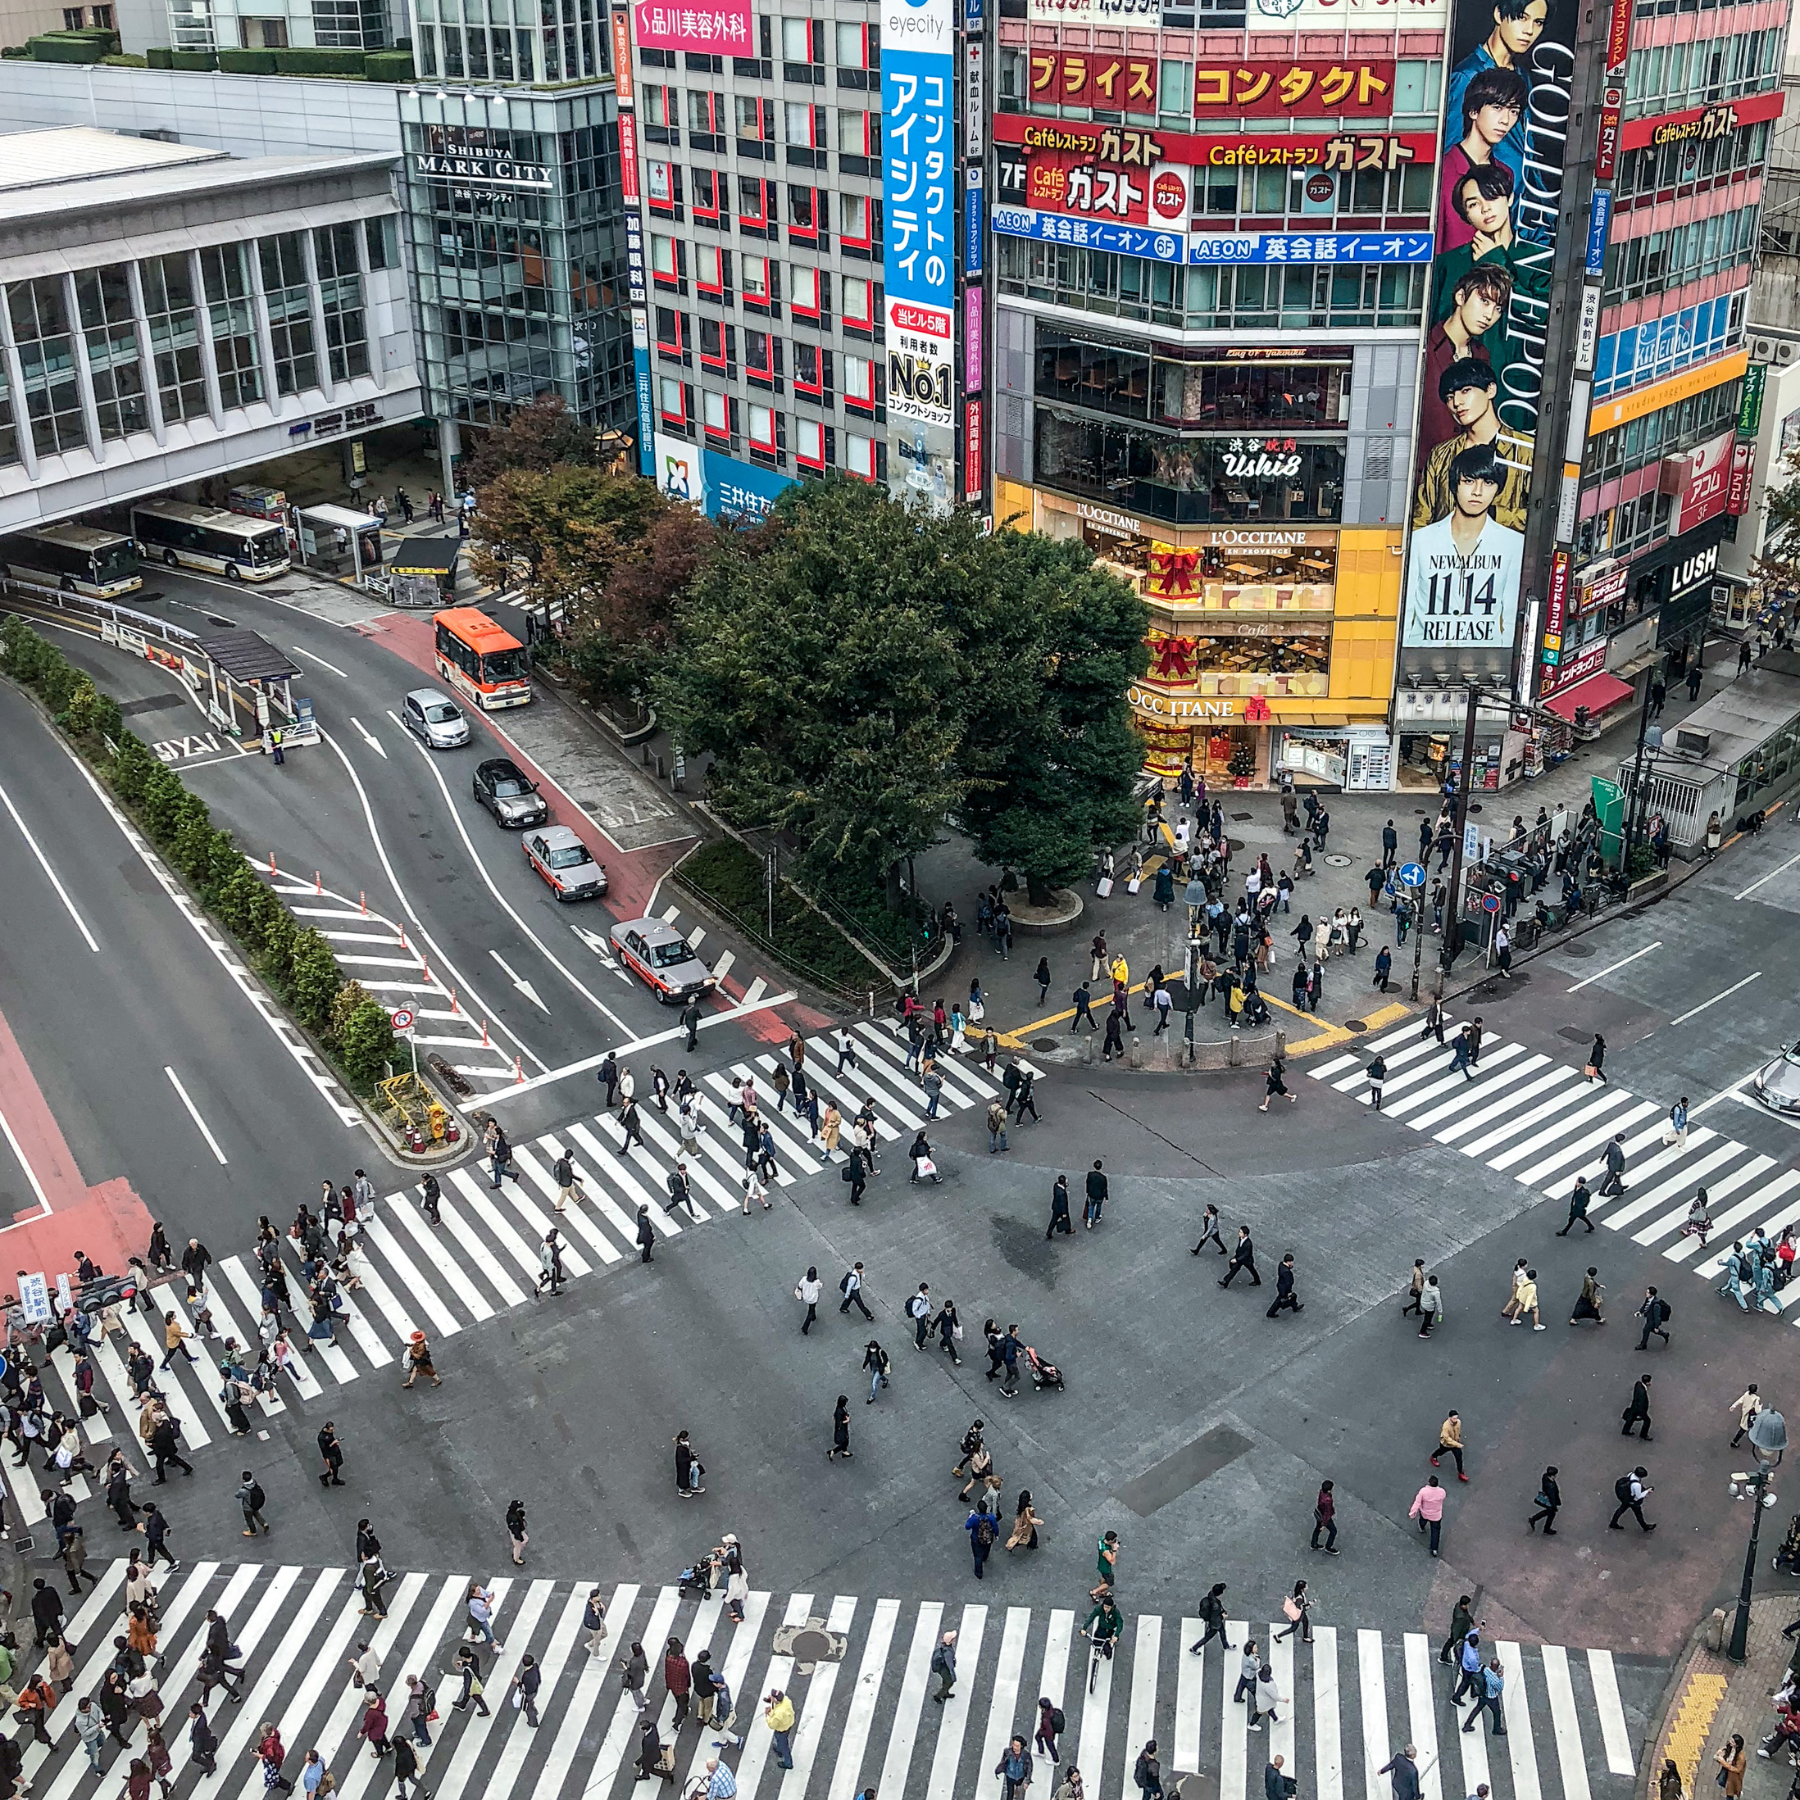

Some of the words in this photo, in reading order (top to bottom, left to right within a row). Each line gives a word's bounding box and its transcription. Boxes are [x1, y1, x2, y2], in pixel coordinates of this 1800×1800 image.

[1616, 0, 1628, 18] イス
[651, 7, 746, 43] 品川美容外科
[889, 15, 944, 41] eyecity
[617, 26, 629, 95] 東京スター銀行
[1614, 66, 1624, 76] 8F
[1032, 55, 1154, 99] プライス
[1197, 66, 1388, 105] コンタクト
[968, 70, 980, 143] 献血ルーム
[1701, 106, 1739, 141] ガスト
[448, 144, 512, 159] SHIBUYA
[970, 146, 979, 155] 6F
[1100, 128, 1161, 166] ガスト
[1209, 144, 1319, 165] Caféレストラン
[1324, 136, 1414, 171] ガスト
[1513, 41, 1576, 276] GOLDEN
[1600, 126, 1617, 169] ガスト
[416, 155, 485, 176] MARK
[495, 162, 552, 181] CITY
[889, 72, 917, 282] アイシティ
[924, 76, 946, 287] コンタクトの
[1001, 163, 1027, 188] 7F
[1033, 166, 1065, 188] Café
[1033, 187, 1064, 202] レストラン
[1066, 166, 1142, 216] ガスト
[1156, 190, 1183, 207] ガスト
[1309, 186, 1332, 195] ガスト
[997, 210, 1031, 232] AEON
[1041, 216, 1149, 252] 英会話イーオン
[1590, 197, 1607, 267] 英会話イーオン
[626, 215, 644, 286] 加藤眼科
[1157, 239, 1173, 254] 6F
[1196, 240, 1252, 259] AEON
[1265, 237, 1428, 261] 英会話イーオン
[632, 289, 644, 299] 5F
[897, 308, 947, 335] 当ビル5階
[1579, 292, 1597, 363] 渋谷駅前ビル
[899, 335, 938, 356] 利用者数
[969, 305, 979, 376] 品川美容外科
[888, 350, 952, 411] No.1
[968, 379, 980, 390] 4F
[1493, 291, 1550, 473] EPOCH
[888, 398, 952, 424] コンタクトショップ
[1228, 437, 1262, 453] 渋谷
[1265, 437, 1297, 453] 焼肉
[1221, 452, 1302, 478] Ushi8
[720, 481, 773, 515] 三井住友
[1690, 470, 1721, 504] アコム
[1730, 472, 1743, 501] アコム
[1076, 502, 1141, 533] L'OCCITANE
[1697, 503, 1709, 520] 3F
[1211, 529, 1307, 545] L'OCCITANE
[1428, 554, 1461, 570] NEW
[1457, 554, 1503, 570] ALBUM
[1671, 544, 1718, 593] LUSH
[1425, 572, 1497, 616] 11.14
[1237, 623, 1269, 639] Café
[1423, 620, 1496, 641] RELEASE
